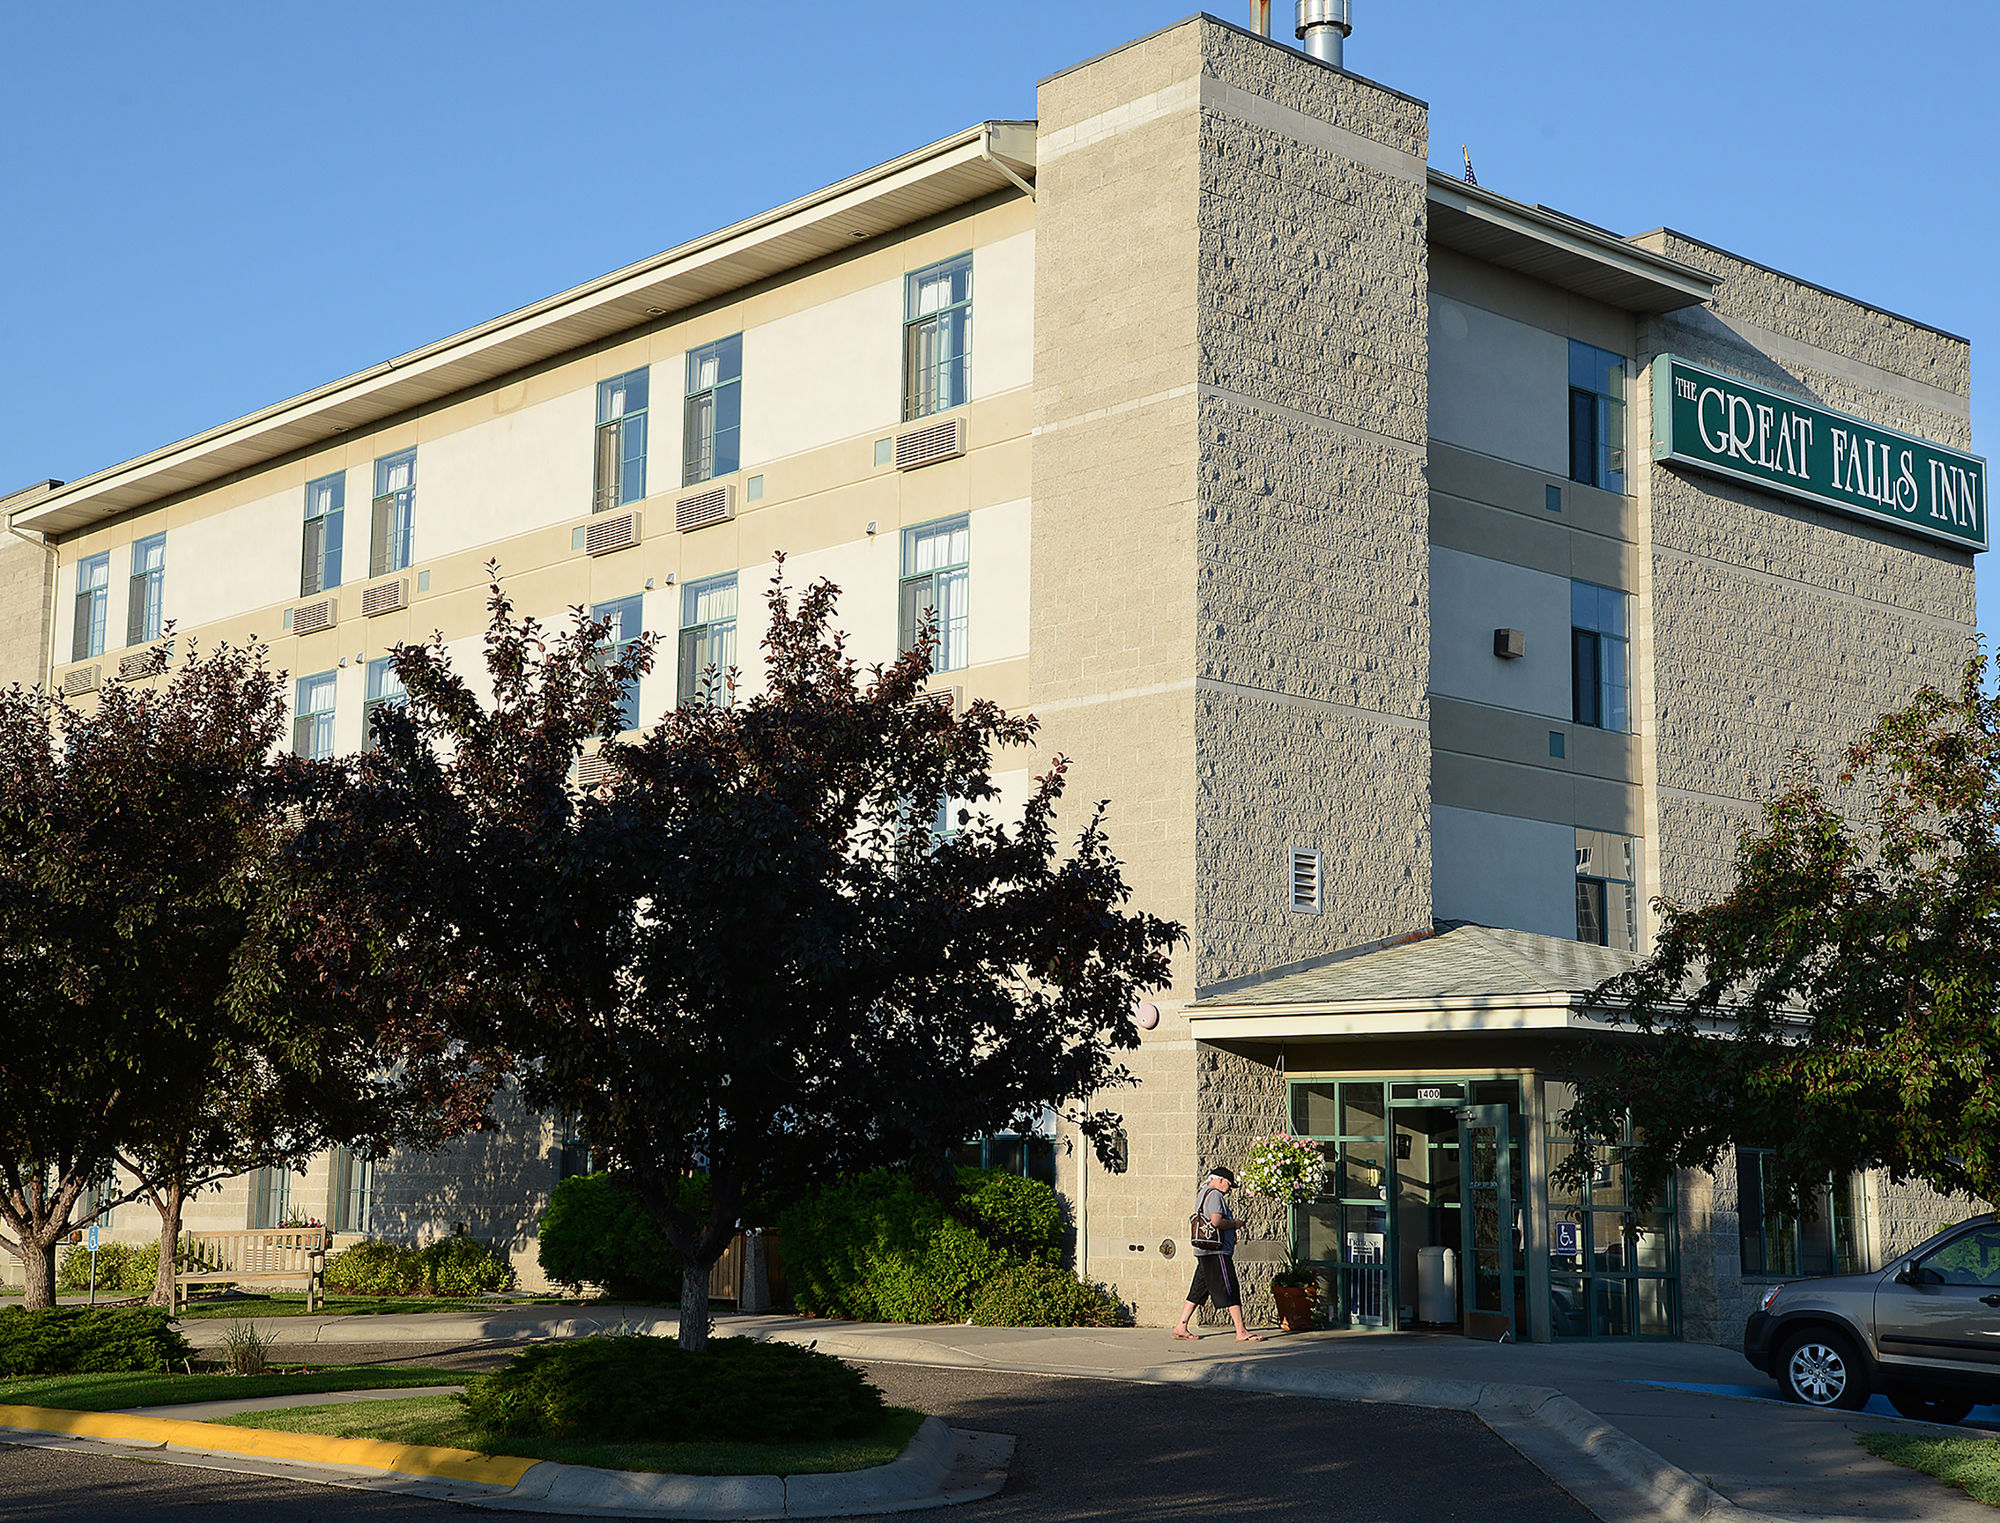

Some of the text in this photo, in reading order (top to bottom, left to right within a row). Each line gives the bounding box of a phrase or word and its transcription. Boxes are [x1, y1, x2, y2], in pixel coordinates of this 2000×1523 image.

[1675, 376, 1978, 531] THE GREAT FALLS INN
[1418, 1089, 1440, 1099] 1400
